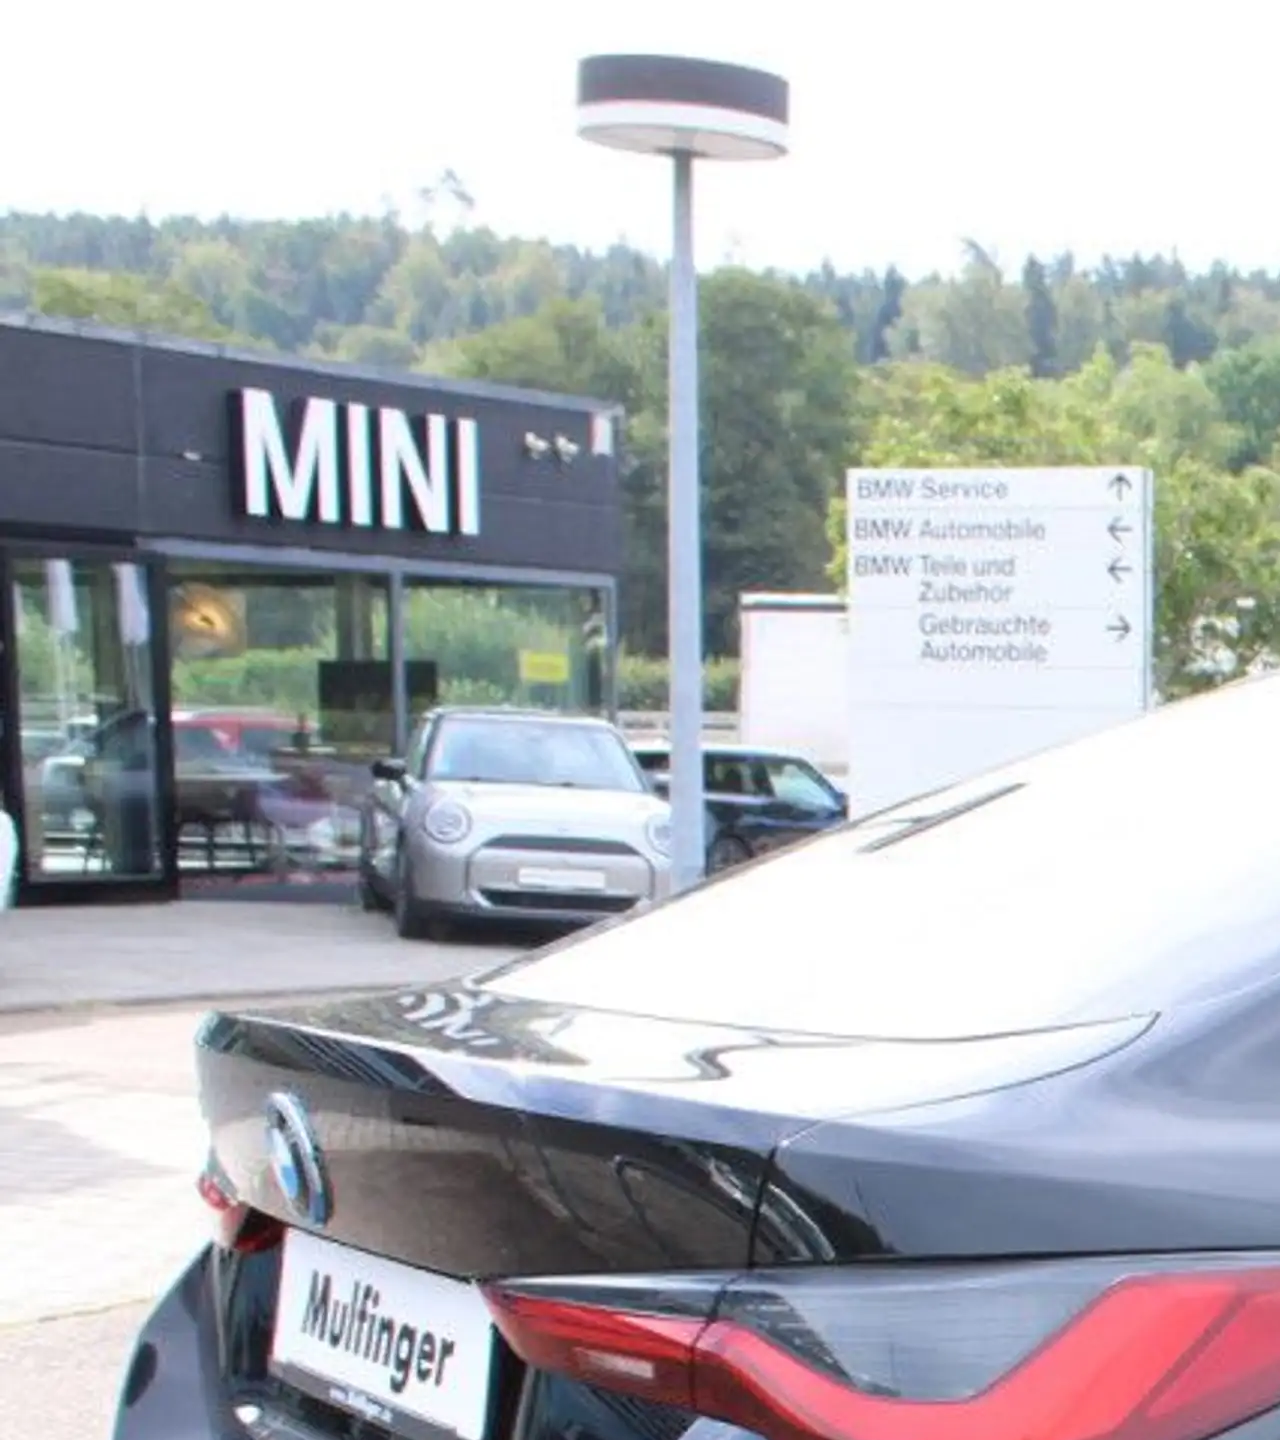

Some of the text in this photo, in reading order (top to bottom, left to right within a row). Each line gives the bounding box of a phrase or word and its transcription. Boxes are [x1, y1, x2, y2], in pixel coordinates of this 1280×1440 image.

[241, 386, 480, 536] MINI
[857, 477, 1009, 499] BMW Service
[855, 517, 1047, 541] BMW Automobile
[855, 554, 1017, 577] BMW Teile und
[918, 612, 1051, 636] Gebrauchte
[920, 641, 1049, 662] Automobile
[301, 1269, 456, 1394] Mulfinger
